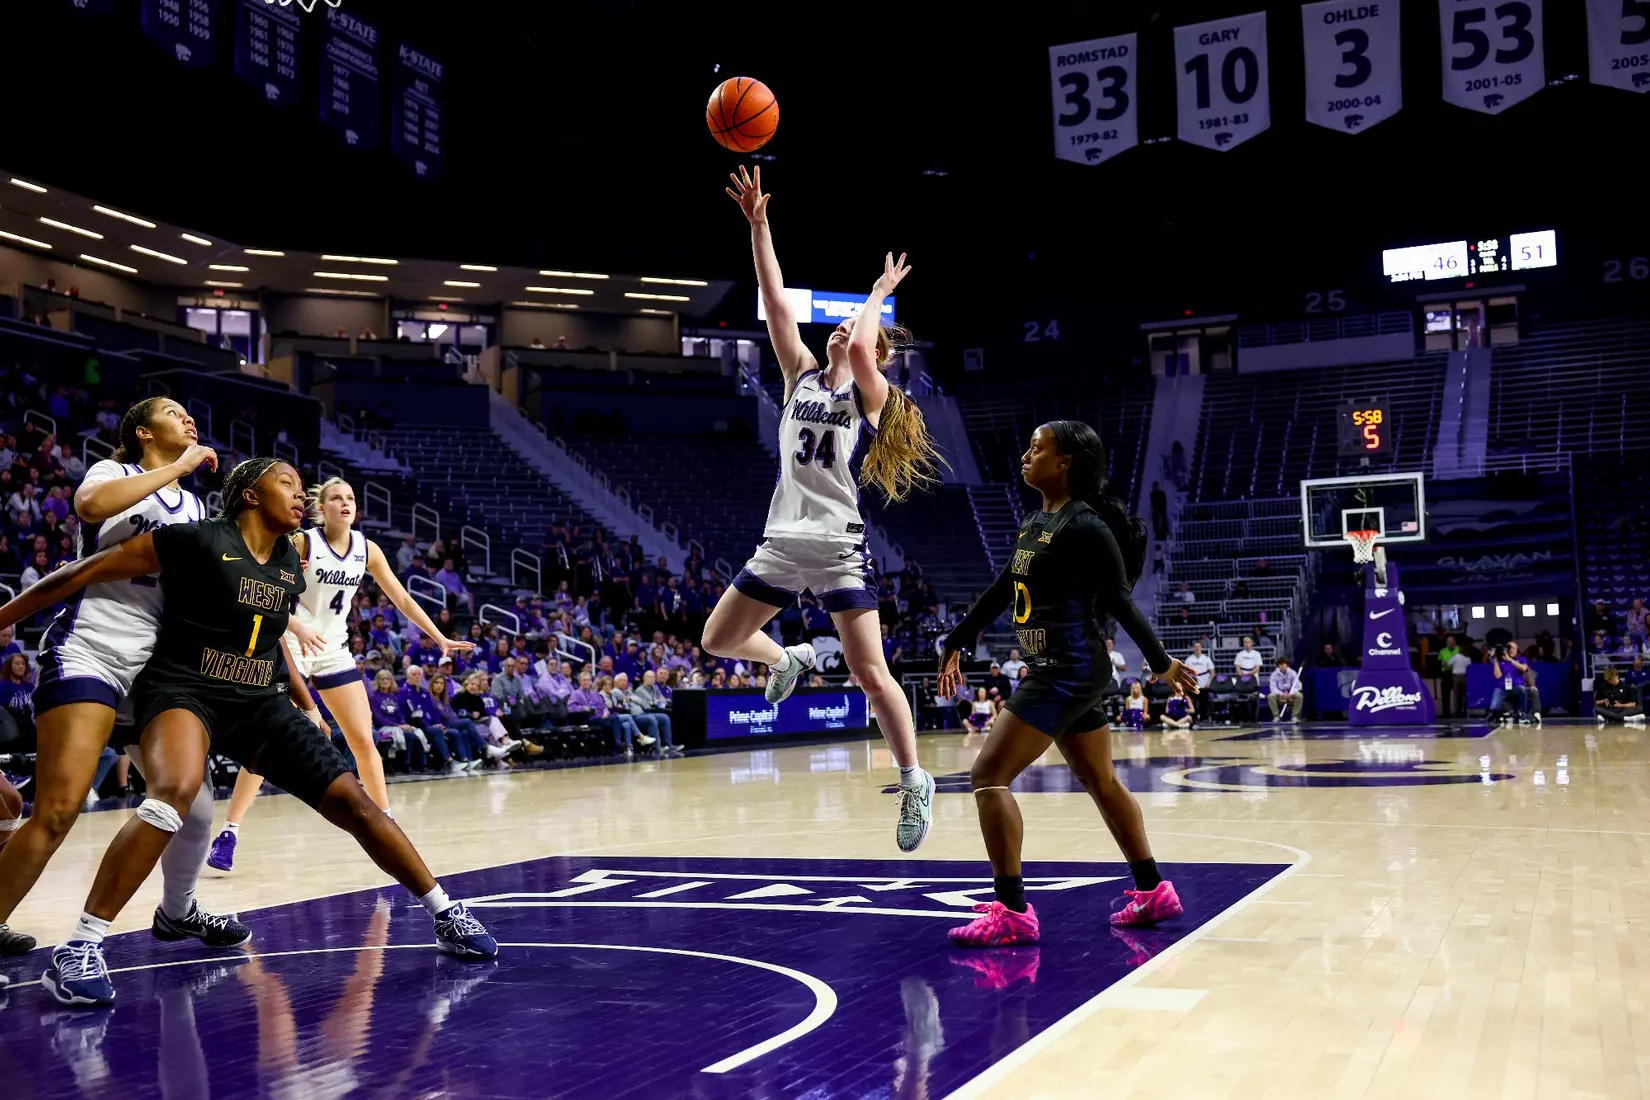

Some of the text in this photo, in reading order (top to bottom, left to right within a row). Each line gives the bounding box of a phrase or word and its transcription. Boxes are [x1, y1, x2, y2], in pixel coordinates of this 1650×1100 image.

[326, 6, 378, 43] K-STATE
[1323, 4, 1379, 24] OHLDE
[1199, 28, 1240, 46] GARY
[1451, 1, 1535, 71] 53
[399, 43, 444, 79] K-STATE
[1057, 45, 1128, 67] ROMSTAD
[1335, 28, 1372, 88] 3
[1185, 46, 1259, 110] 10
[1464, 73, 1523, 92] 2001-05
[1059, 65, 1130, 127] 33
[1327, 94, 1381, 112] 2000-04
[1199, 113, 1249, 130] 1981-83
[1070, 129, 1118, 146] 1979-82
[1433, 255, 1458, 270] 46
[1521, 245, 1543, 260] 51
[1602, 256, 1650, 284] 26
[1304, 289, 1347, 314] 25
[1023, 319, 1061, 343] 24
[790, 398, 852, 429] Wildcats
[1352, 409, 1383, 426] 5:58
[796, 426, 837, 469] 34
[1363, 424, 1380, 449] 5
[237, 576, 286, 612] WEST
[329, 589, 345, 616] 4
[243, 614, 264, 658] 1
[1368, 647, 1402, 656] Channel
[1352, 686, 1421, 712] Dillons
